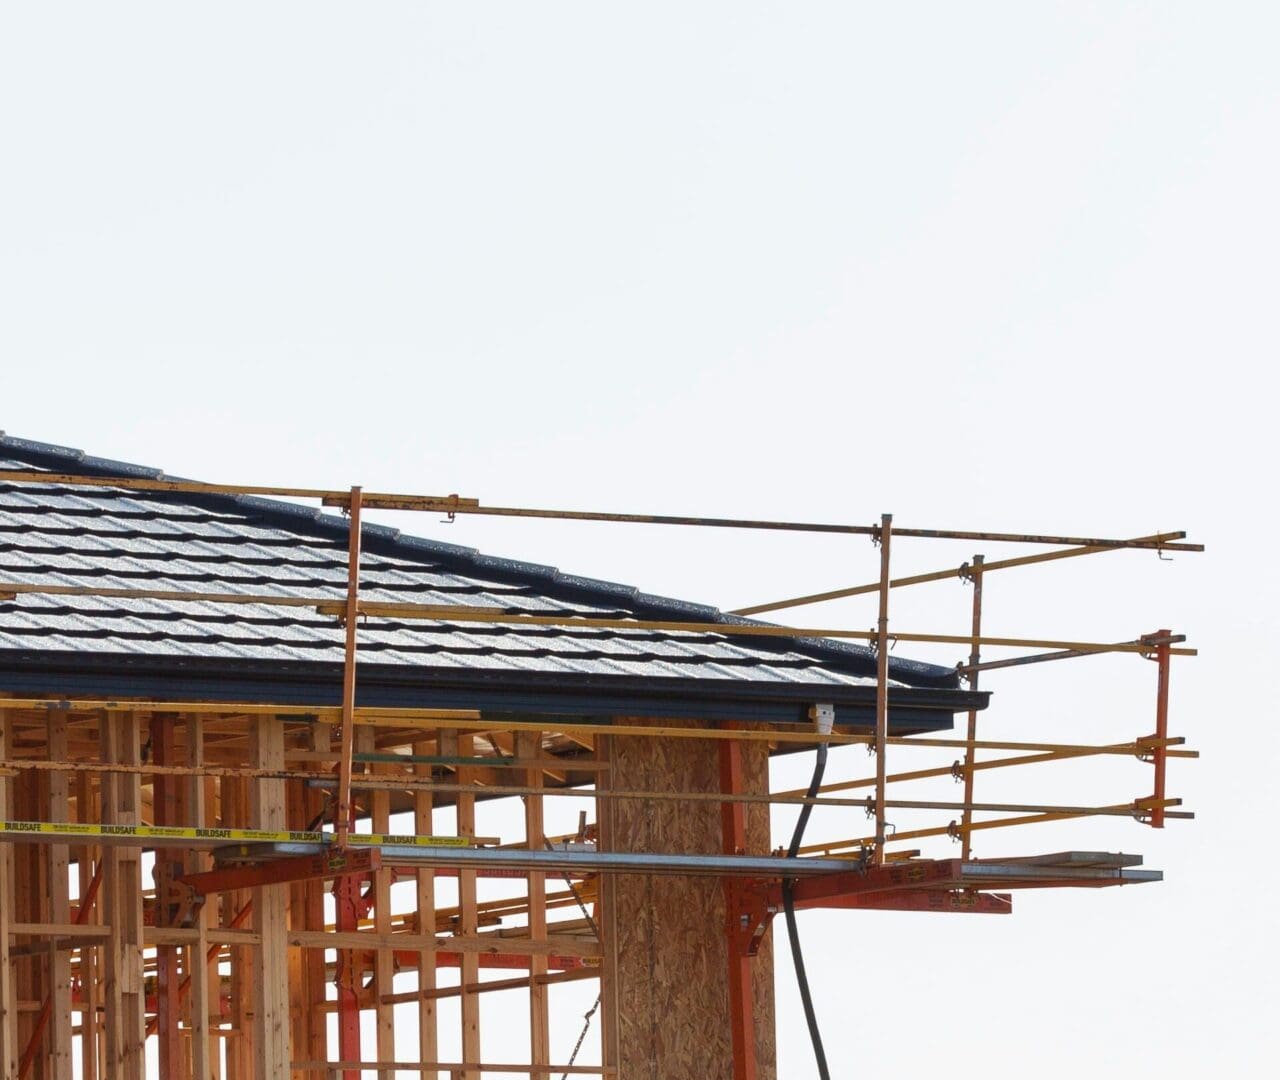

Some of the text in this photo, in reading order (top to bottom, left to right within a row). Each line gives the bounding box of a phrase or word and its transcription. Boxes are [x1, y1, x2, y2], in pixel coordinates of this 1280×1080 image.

[4, 822, 42, 831] BUILDSAFE
[101, 825, 136, 834] BUILDSAFE
[196, 829, 231, 838] BUILDSAFE
[290, 832, 323, 841] BUILDSAF
[383, 836, 417, 844] BUILDSAFE
